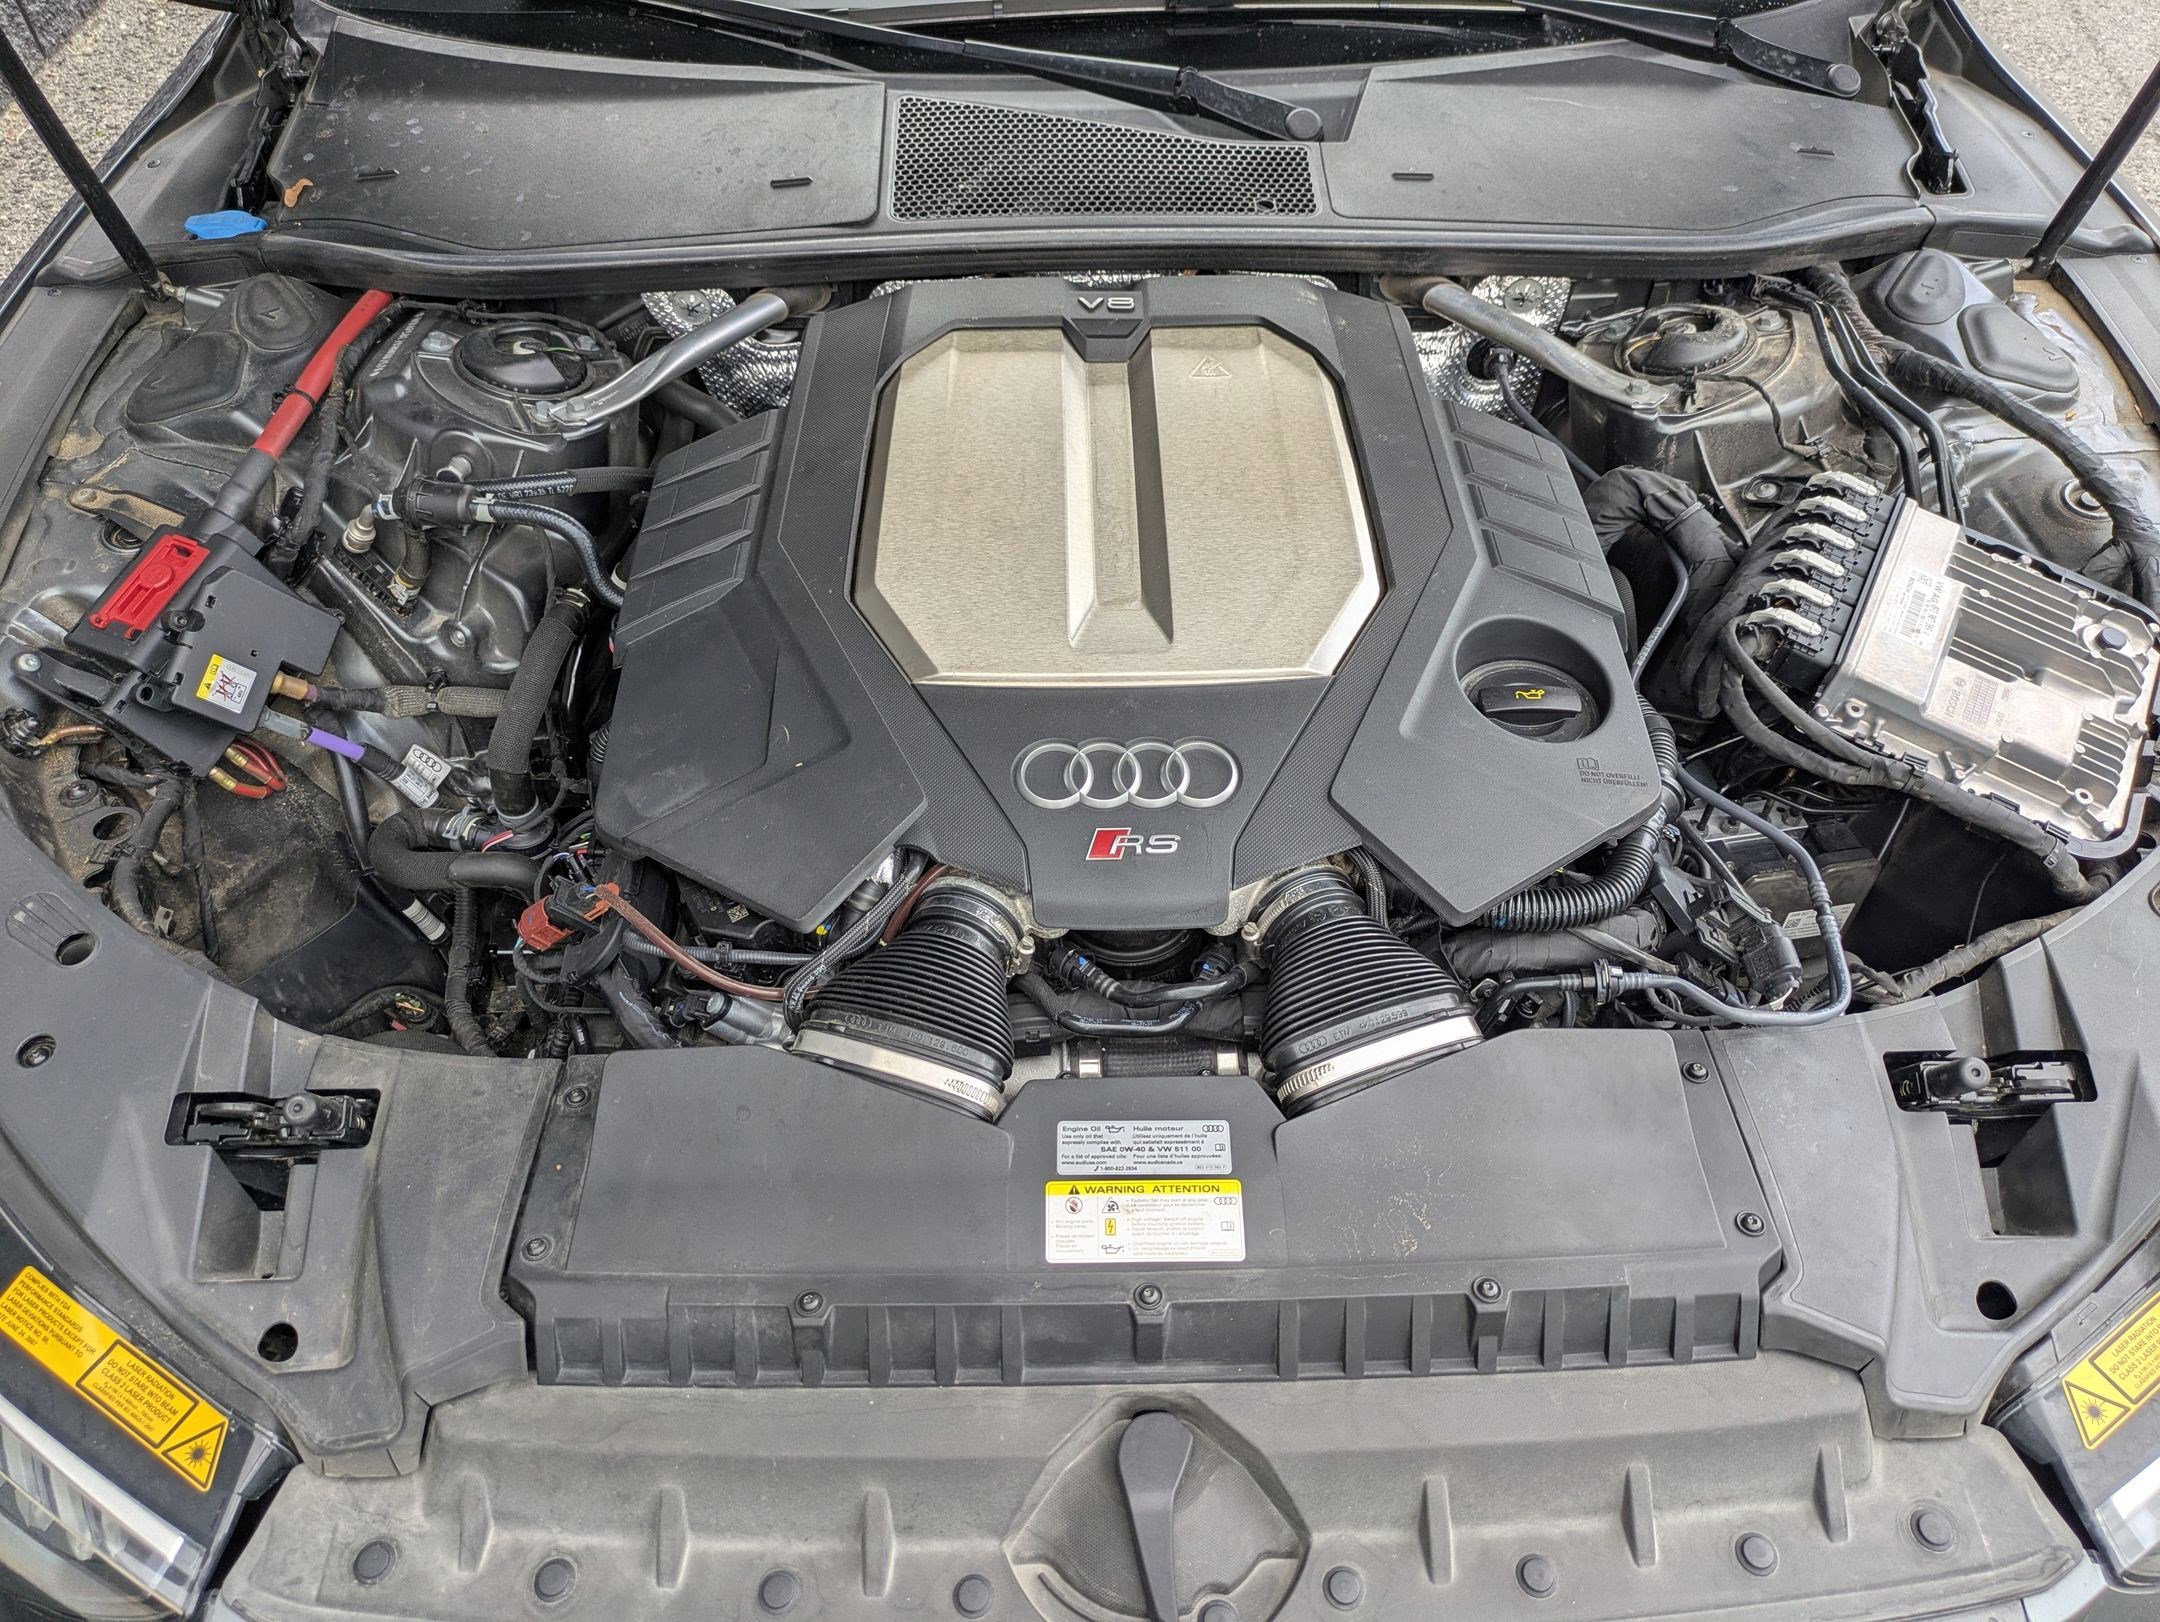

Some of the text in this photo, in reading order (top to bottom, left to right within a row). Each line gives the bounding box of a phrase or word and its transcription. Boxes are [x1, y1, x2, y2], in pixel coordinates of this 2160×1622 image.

[1078, 297, 1135, 312] V8
[1110, 834, 1181, 855] RS
[1062, 1125, 1088, 1133] Engine
[1084, 1184, 1221, 1194] WARNING ATTENTION
[19, 1280, 82, 1331] PERFORMANCE STANDARDS
[25, 1273, 70, 1310] COMPLIES WITH FDA
[0, 1303, 16, 1316] LASER
[16, 1315, 33, 1330] NOTICE
[6, 1320, 18, 1331] JUNE
[7, 1295, 22, 1309] LASER
[22, 1307, 49, 1330] DEVIATIONS
[49, 1329, 75, 1351] PURSUANT
[13, 1287, 95, 1354] FOR LASER PRODUCTS EXCEPT FOR
[2112, 1315, 2156, 1356] LASER RADIATION
[2110, 1364, 2118, 1373] DO
[2118, 1354, 2129, 1365] NOT
[2129, 1338, 2146, 1355] STARE
[2145, 1328, 2157, 1340] INTO
[2119, 1362, 2137, 1379] CLASS
[2140, 1343, 2157, 1360] LASER
[101, 1367, 120, 1384] CLASS
[125, 1385, 143, 1402] LASER
[143, 1400, 170, 1423] PRODUCT
[108, 1359, 177, 1415] DO NOT STARE INTO BEAM
[127, 1360, 174, 1399] LASER RADIATION
